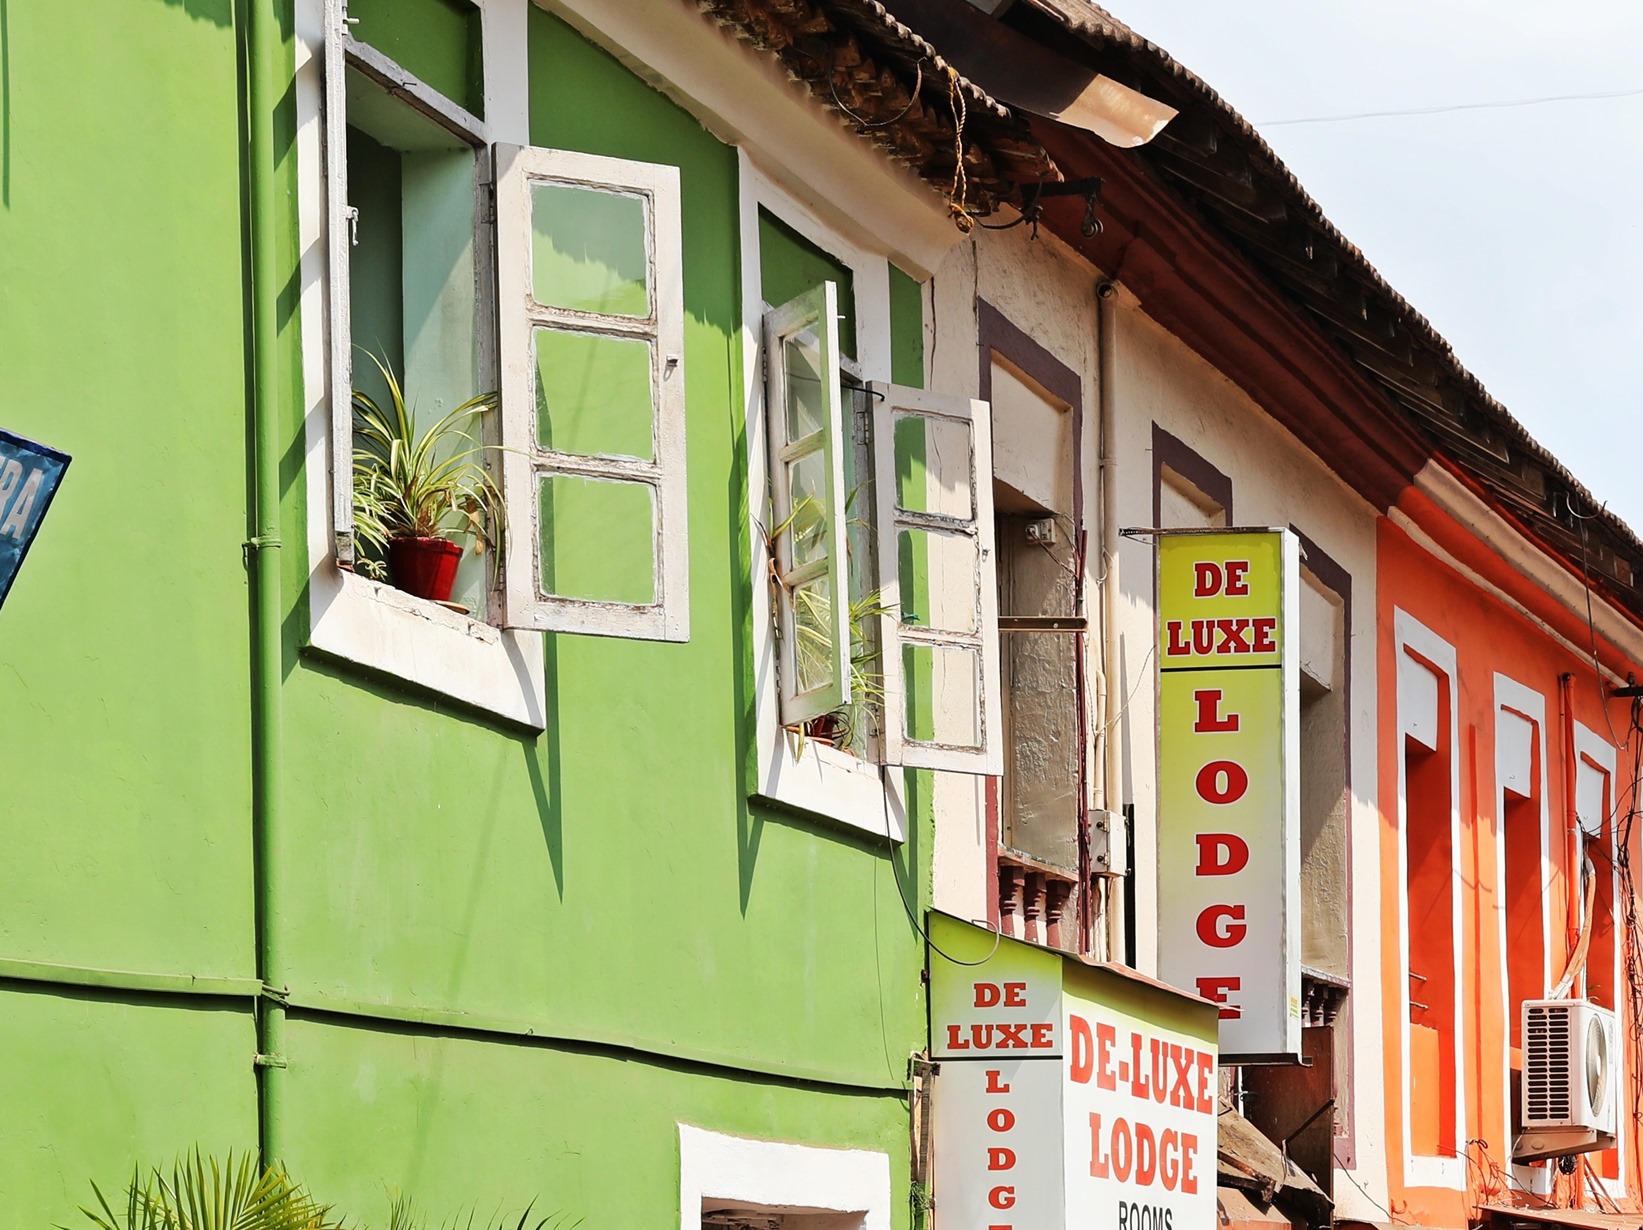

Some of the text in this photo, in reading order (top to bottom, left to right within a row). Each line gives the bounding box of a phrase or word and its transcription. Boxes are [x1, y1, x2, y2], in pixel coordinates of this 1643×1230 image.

[1193, 560, 1248, 598] DE
[1166, 617, 1276, 656] LUXE
[1193, 688, 1250, 1019] LODGE
[973, 982, 1027, 1008] DE
[947, 1023, 1053, 1050] LUXE
[1069, 1014, 1213, 1115] DE-LUXE
[1089, 1112, 1198, 1195] LODGE
